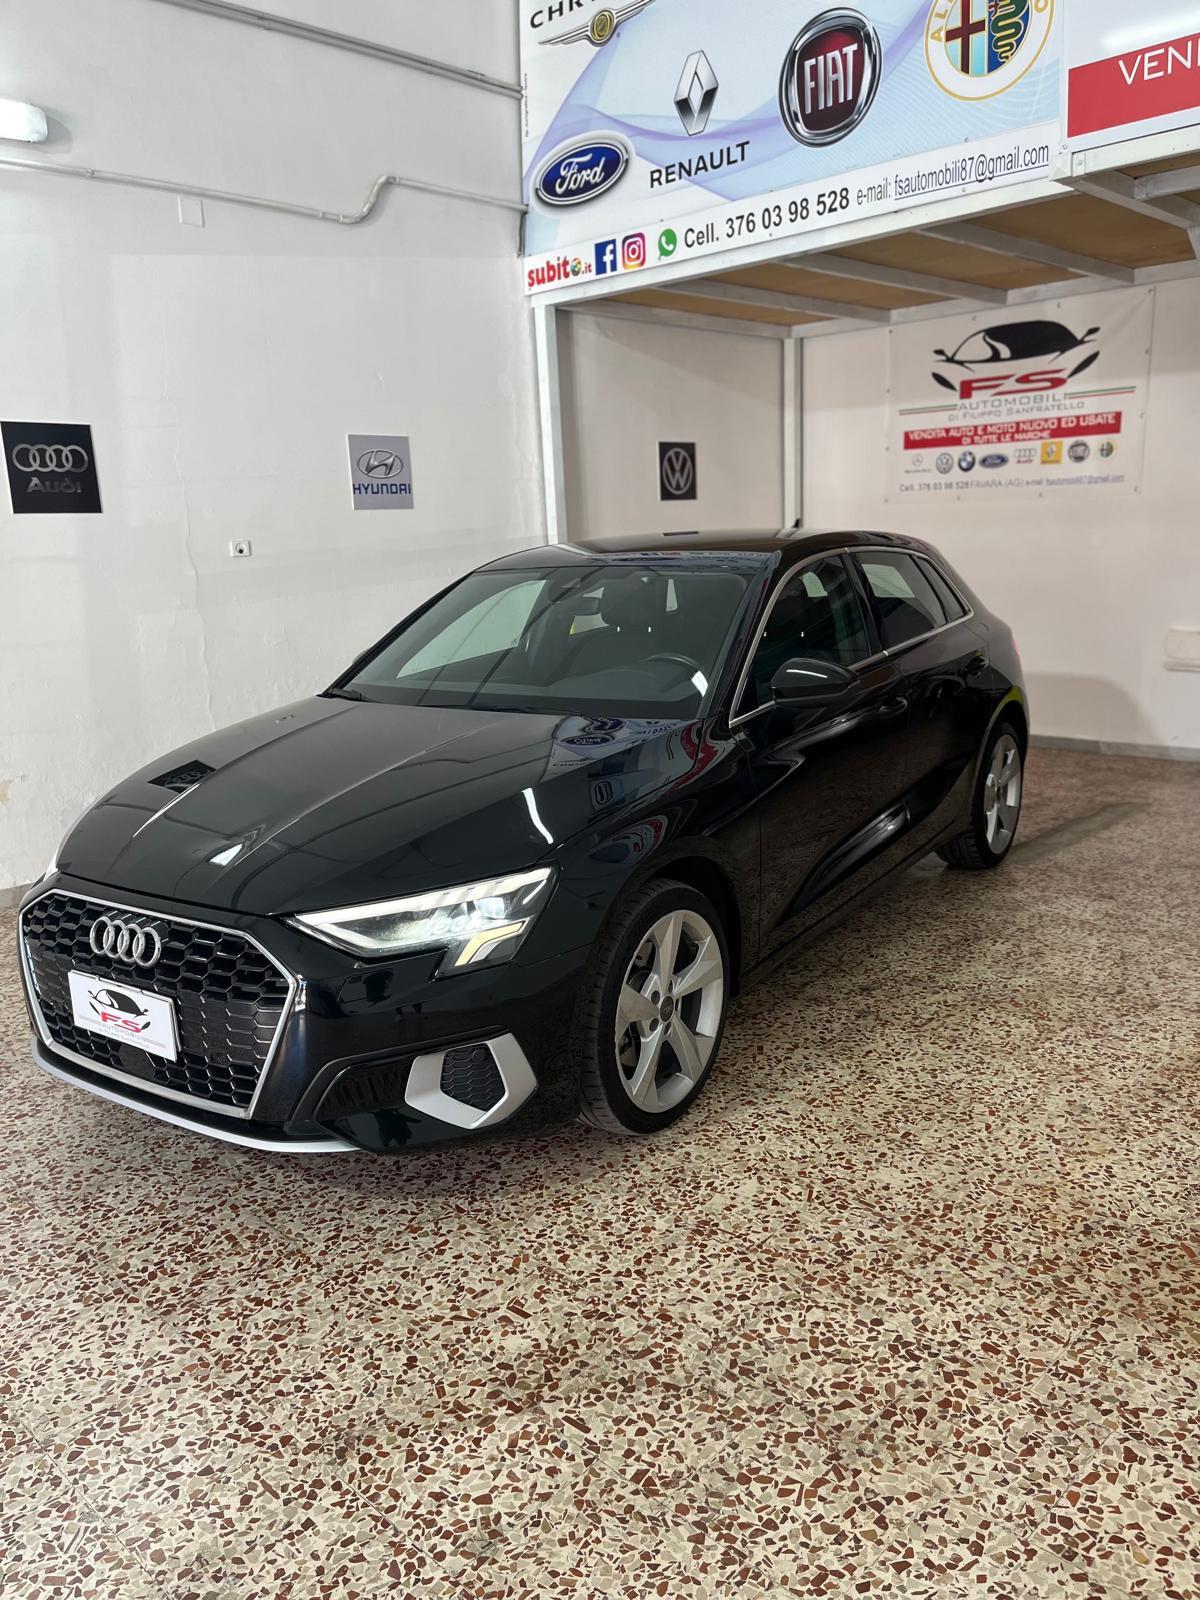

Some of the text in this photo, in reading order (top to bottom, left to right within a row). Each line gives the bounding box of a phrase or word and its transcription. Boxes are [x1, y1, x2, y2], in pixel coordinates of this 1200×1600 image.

[530, 0, 599, 29] CHR
[1118, 38, 1200, 85] VEN
[804, 43, 858, 115] FIAT
[555, 153, 604, 195] Ford
[650, 141, 750, 189] RENAULT
[684, 145, 1049, 248] Cell. 376 03 98 528 e-mail: fsautomobili87@gmail.com
[960, 368, 1068, 399] FS
[959, 392, 1066, 410] AUTOMOBILI
[909, 413, 1116, 440] VENDITA AUTO E MOTO NUOVO ED USATE
[961, 430, 1050, 445] DI TUTTE LE MARCHE
[26, 477, 82, 494] Audi
[352, 483, 412, 496] HYUNDAI
[101, 1011, 142, 1033] FS
